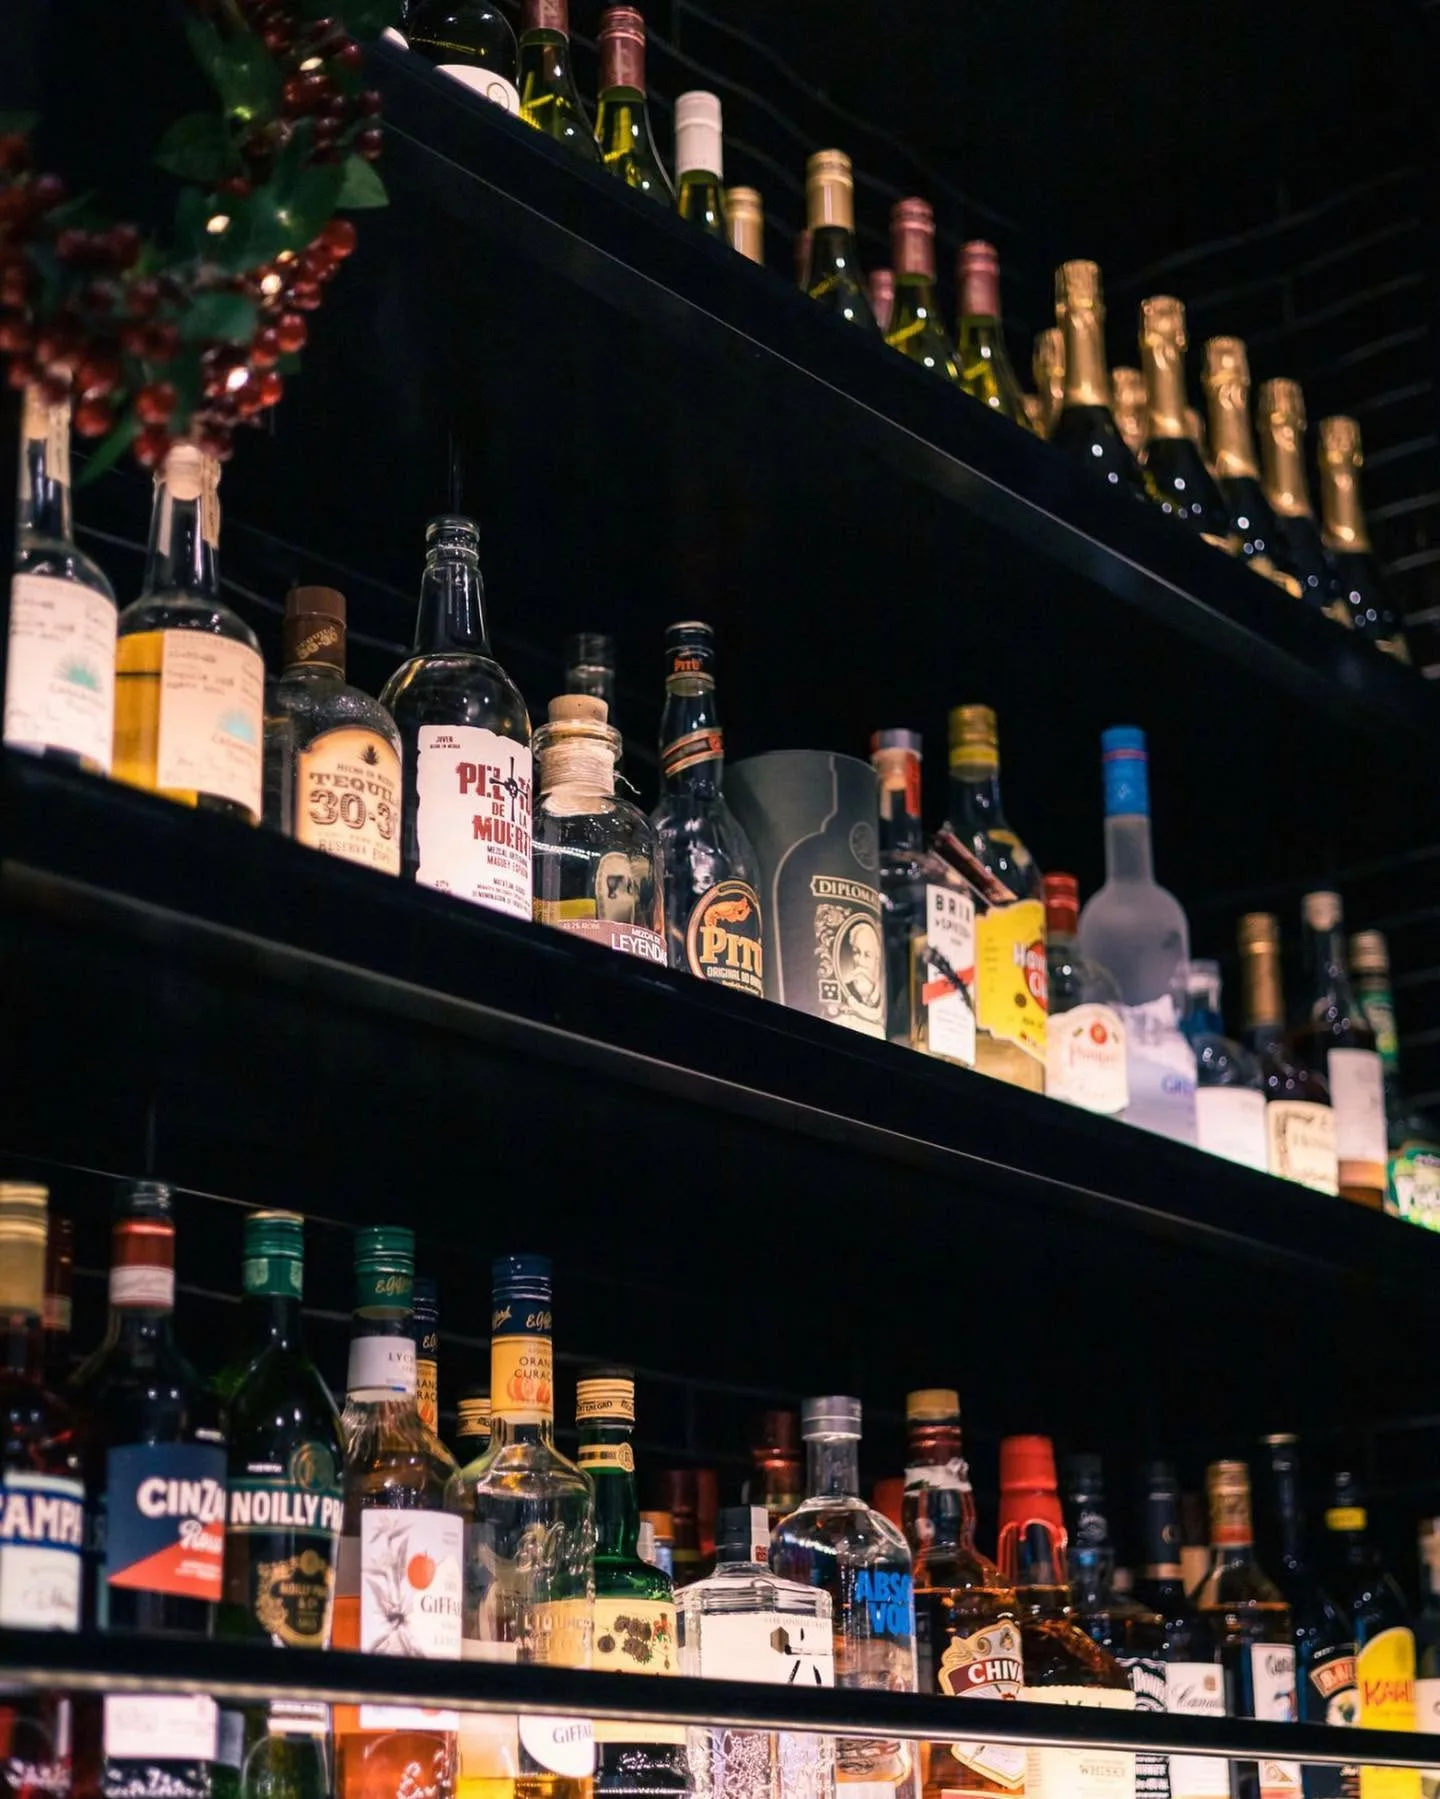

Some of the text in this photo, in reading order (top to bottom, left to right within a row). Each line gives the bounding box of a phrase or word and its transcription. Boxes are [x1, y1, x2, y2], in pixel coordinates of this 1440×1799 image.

[492, 801, 505, 818] DE
[519, 810, 528, 829] LA
[231, 1490, 319, 1527] NOILLY
